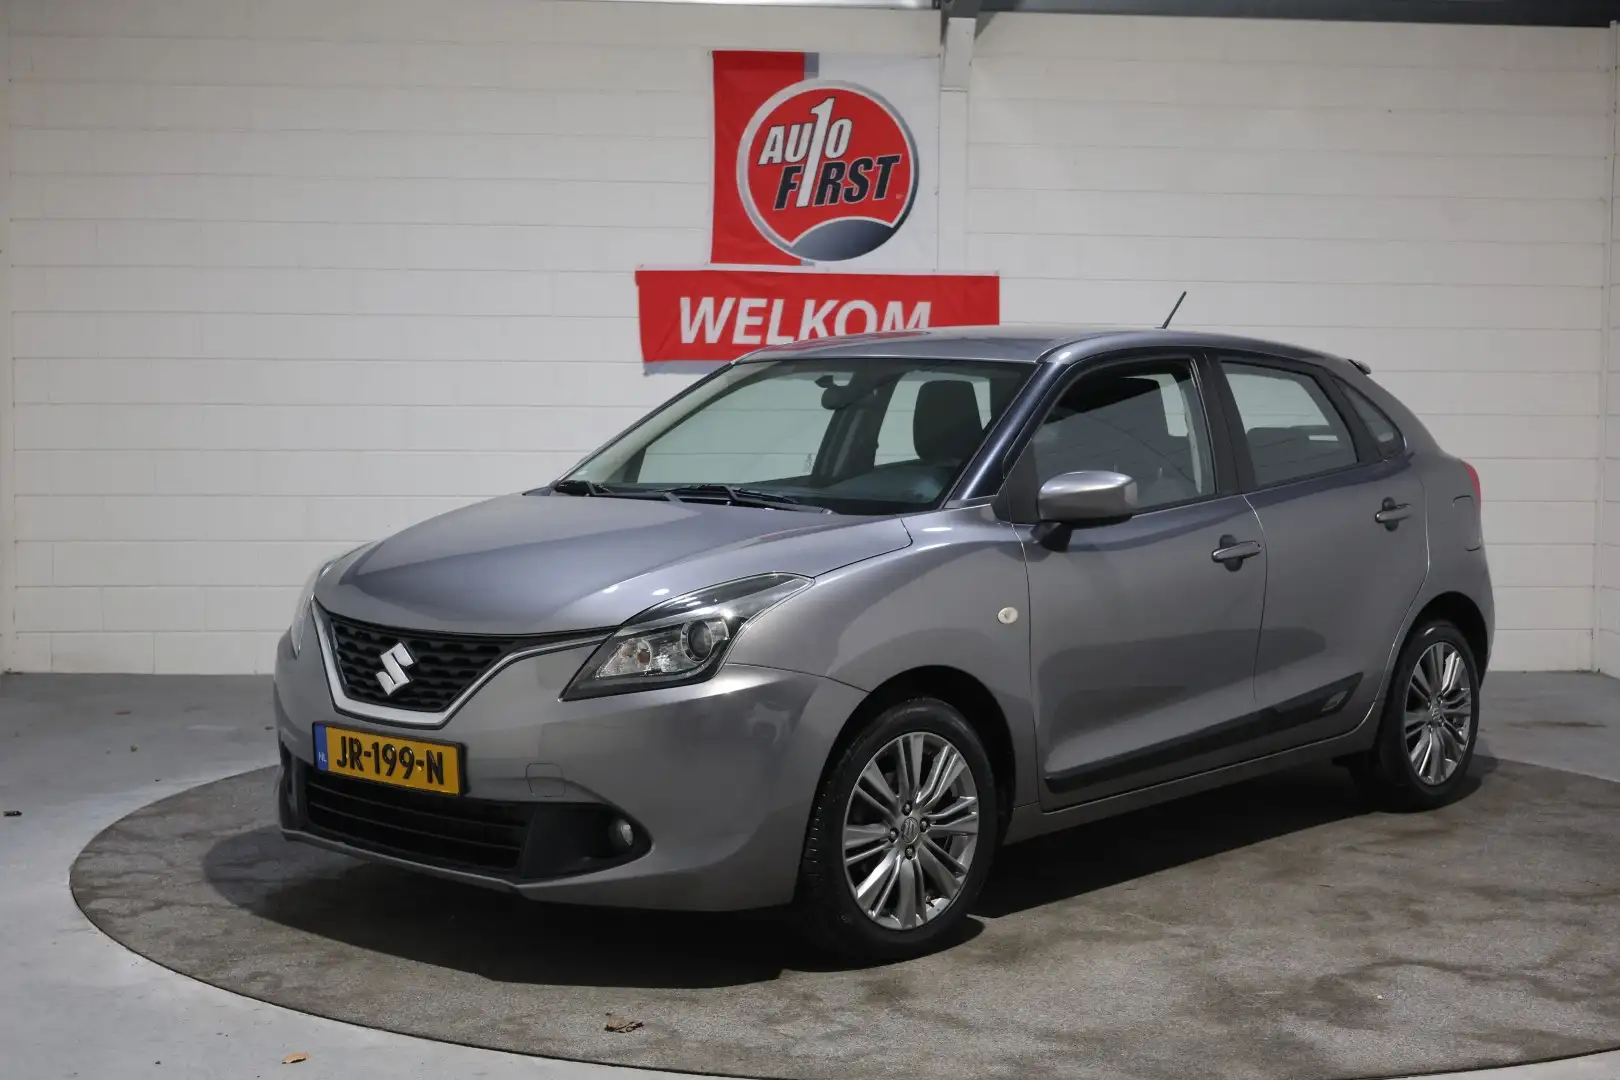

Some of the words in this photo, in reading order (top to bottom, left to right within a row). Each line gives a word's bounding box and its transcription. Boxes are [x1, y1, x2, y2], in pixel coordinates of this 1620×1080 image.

[679, 296, 932, 345] WELKOM
[318, 751, 328, 763] NL
[336, 735, 445, 785] JR-199-N
